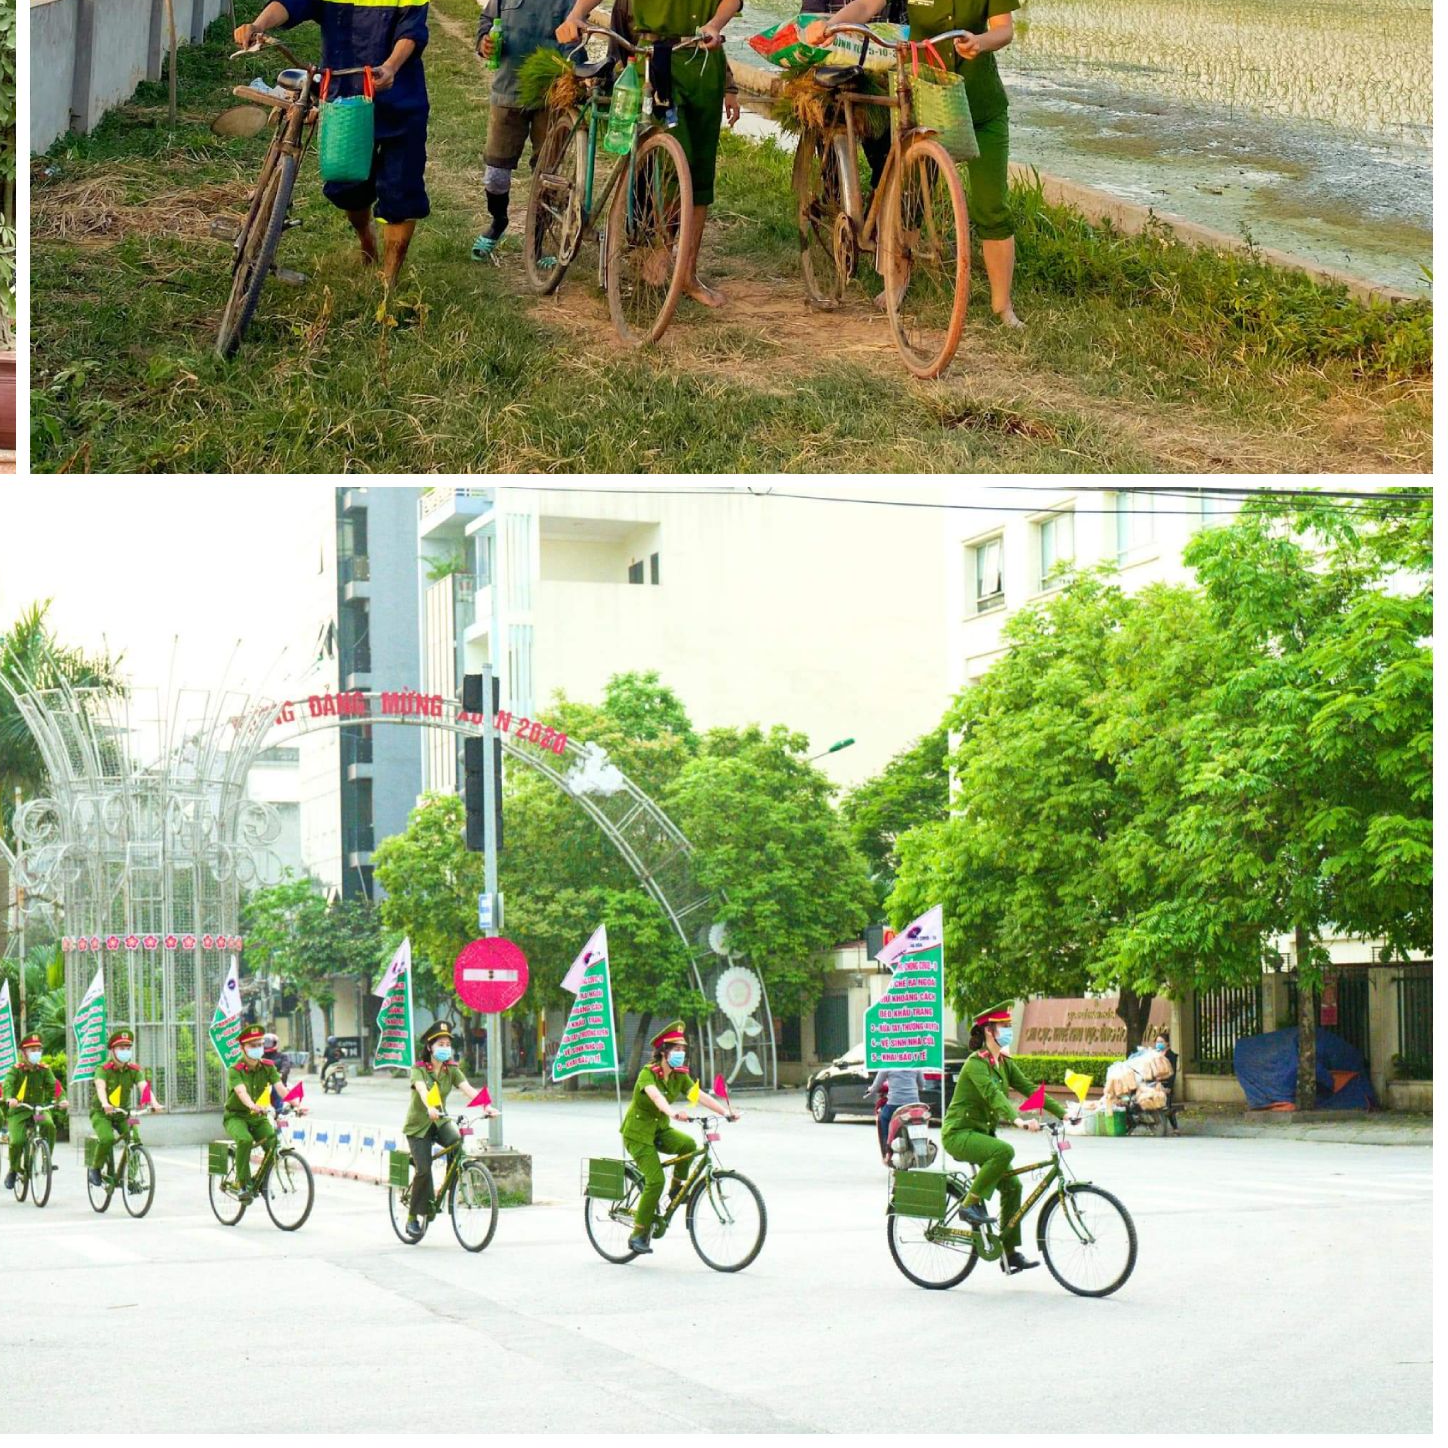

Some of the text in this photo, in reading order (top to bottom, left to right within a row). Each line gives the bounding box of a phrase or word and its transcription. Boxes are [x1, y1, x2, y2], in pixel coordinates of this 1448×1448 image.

[307, 684, 366, 718] ĐẢNG
[381, 686, 442, 717] MỪNG
[515, 717, 567, 754] 2020
[891, 991, 918, 1003] KHOẢNG
